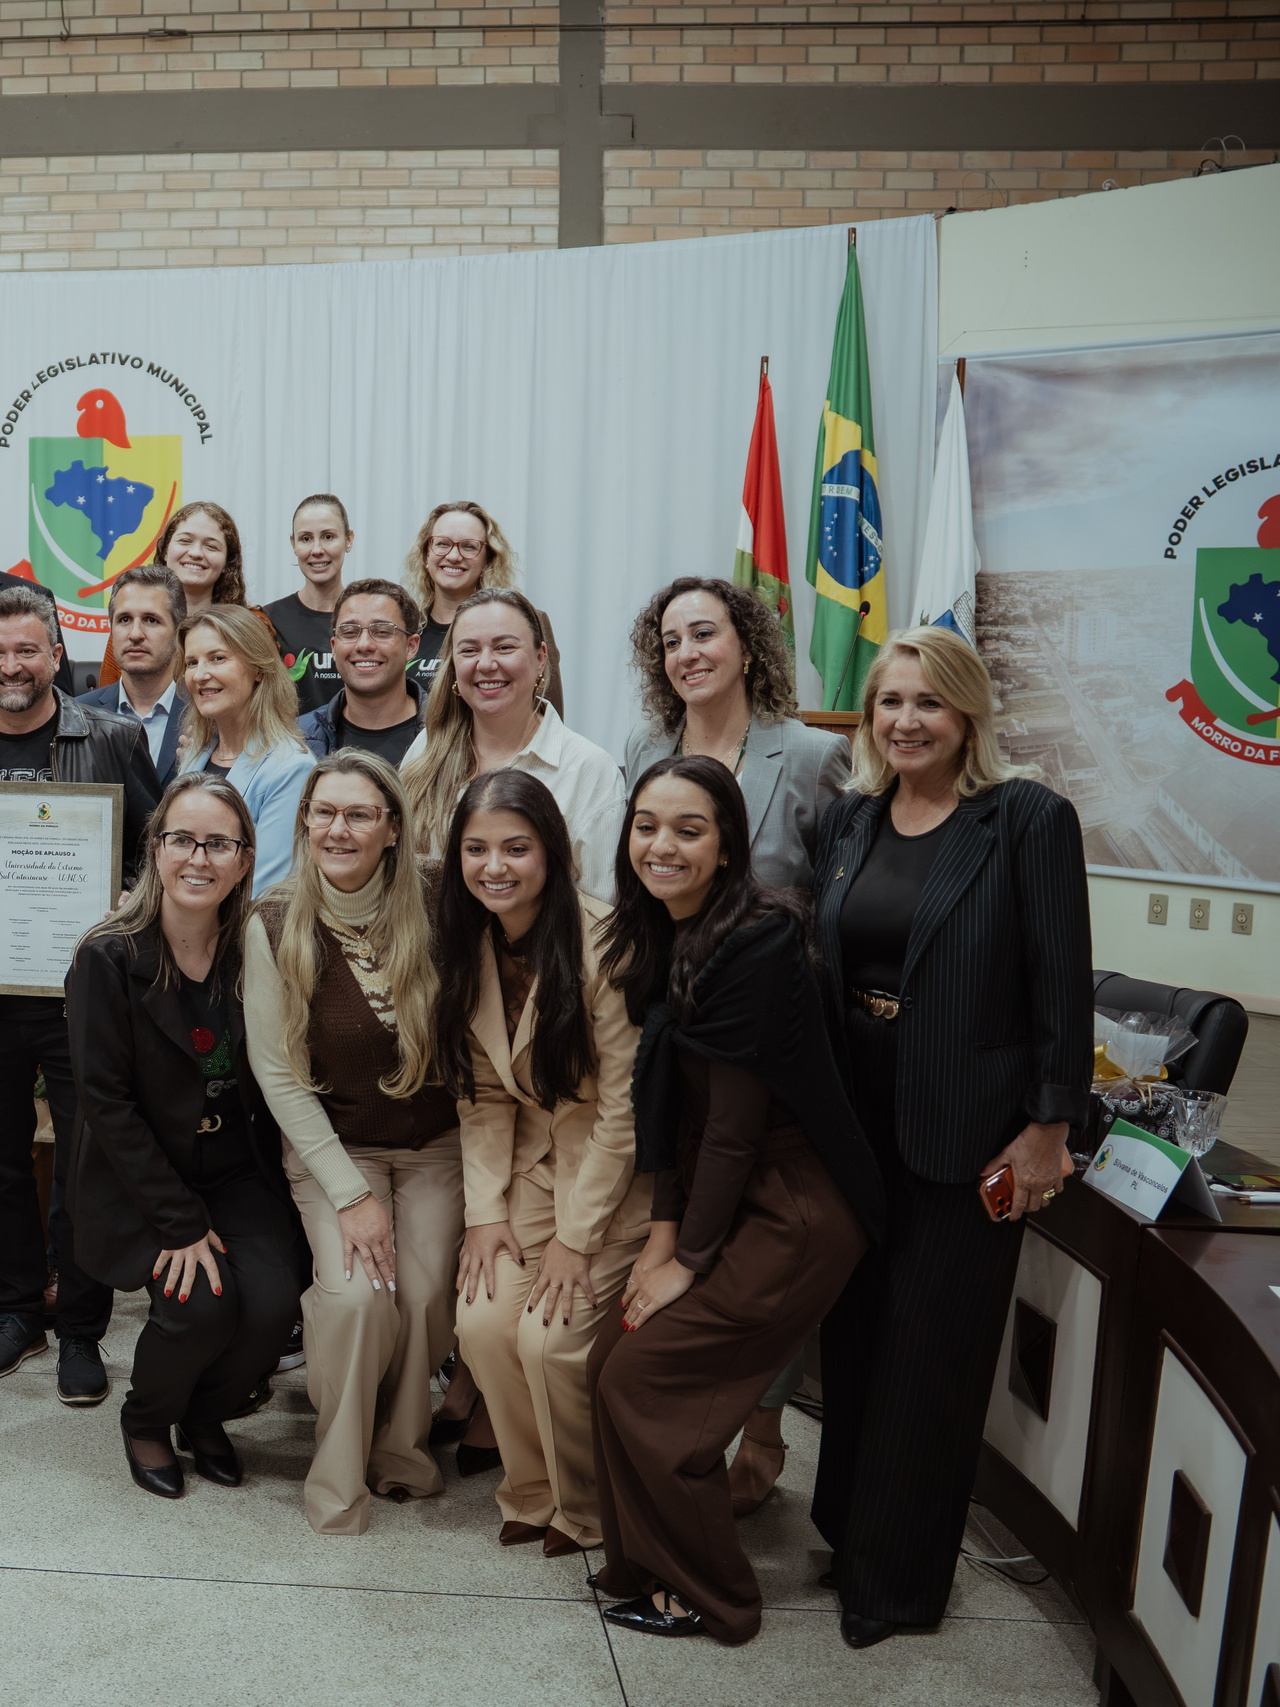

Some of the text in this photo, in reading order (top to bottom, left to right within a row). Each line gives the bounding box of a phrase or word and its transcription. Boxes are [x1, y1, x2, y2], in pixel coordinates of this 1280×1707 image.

[30, 351, 144, 391] LEGISLATIVO
[146, 361, 213, 445] MUNICIPAL
[1163, 453, 1280, 560] PODER LEGISLA
[77, 616, 97, 630] DA
[1190, 716, 1242, 753] MORRO
[1243, 745, 1266, 761] DA
[5, 860, 46, 870] Universidade
[11, 871, 48, 881] Catarinense
[58, 873, 89, 882] UNESC
[1113, 1158, 1169, 1193] Silvana de Vasconcelos
[1130, 1181, 1138, 1190] PL
